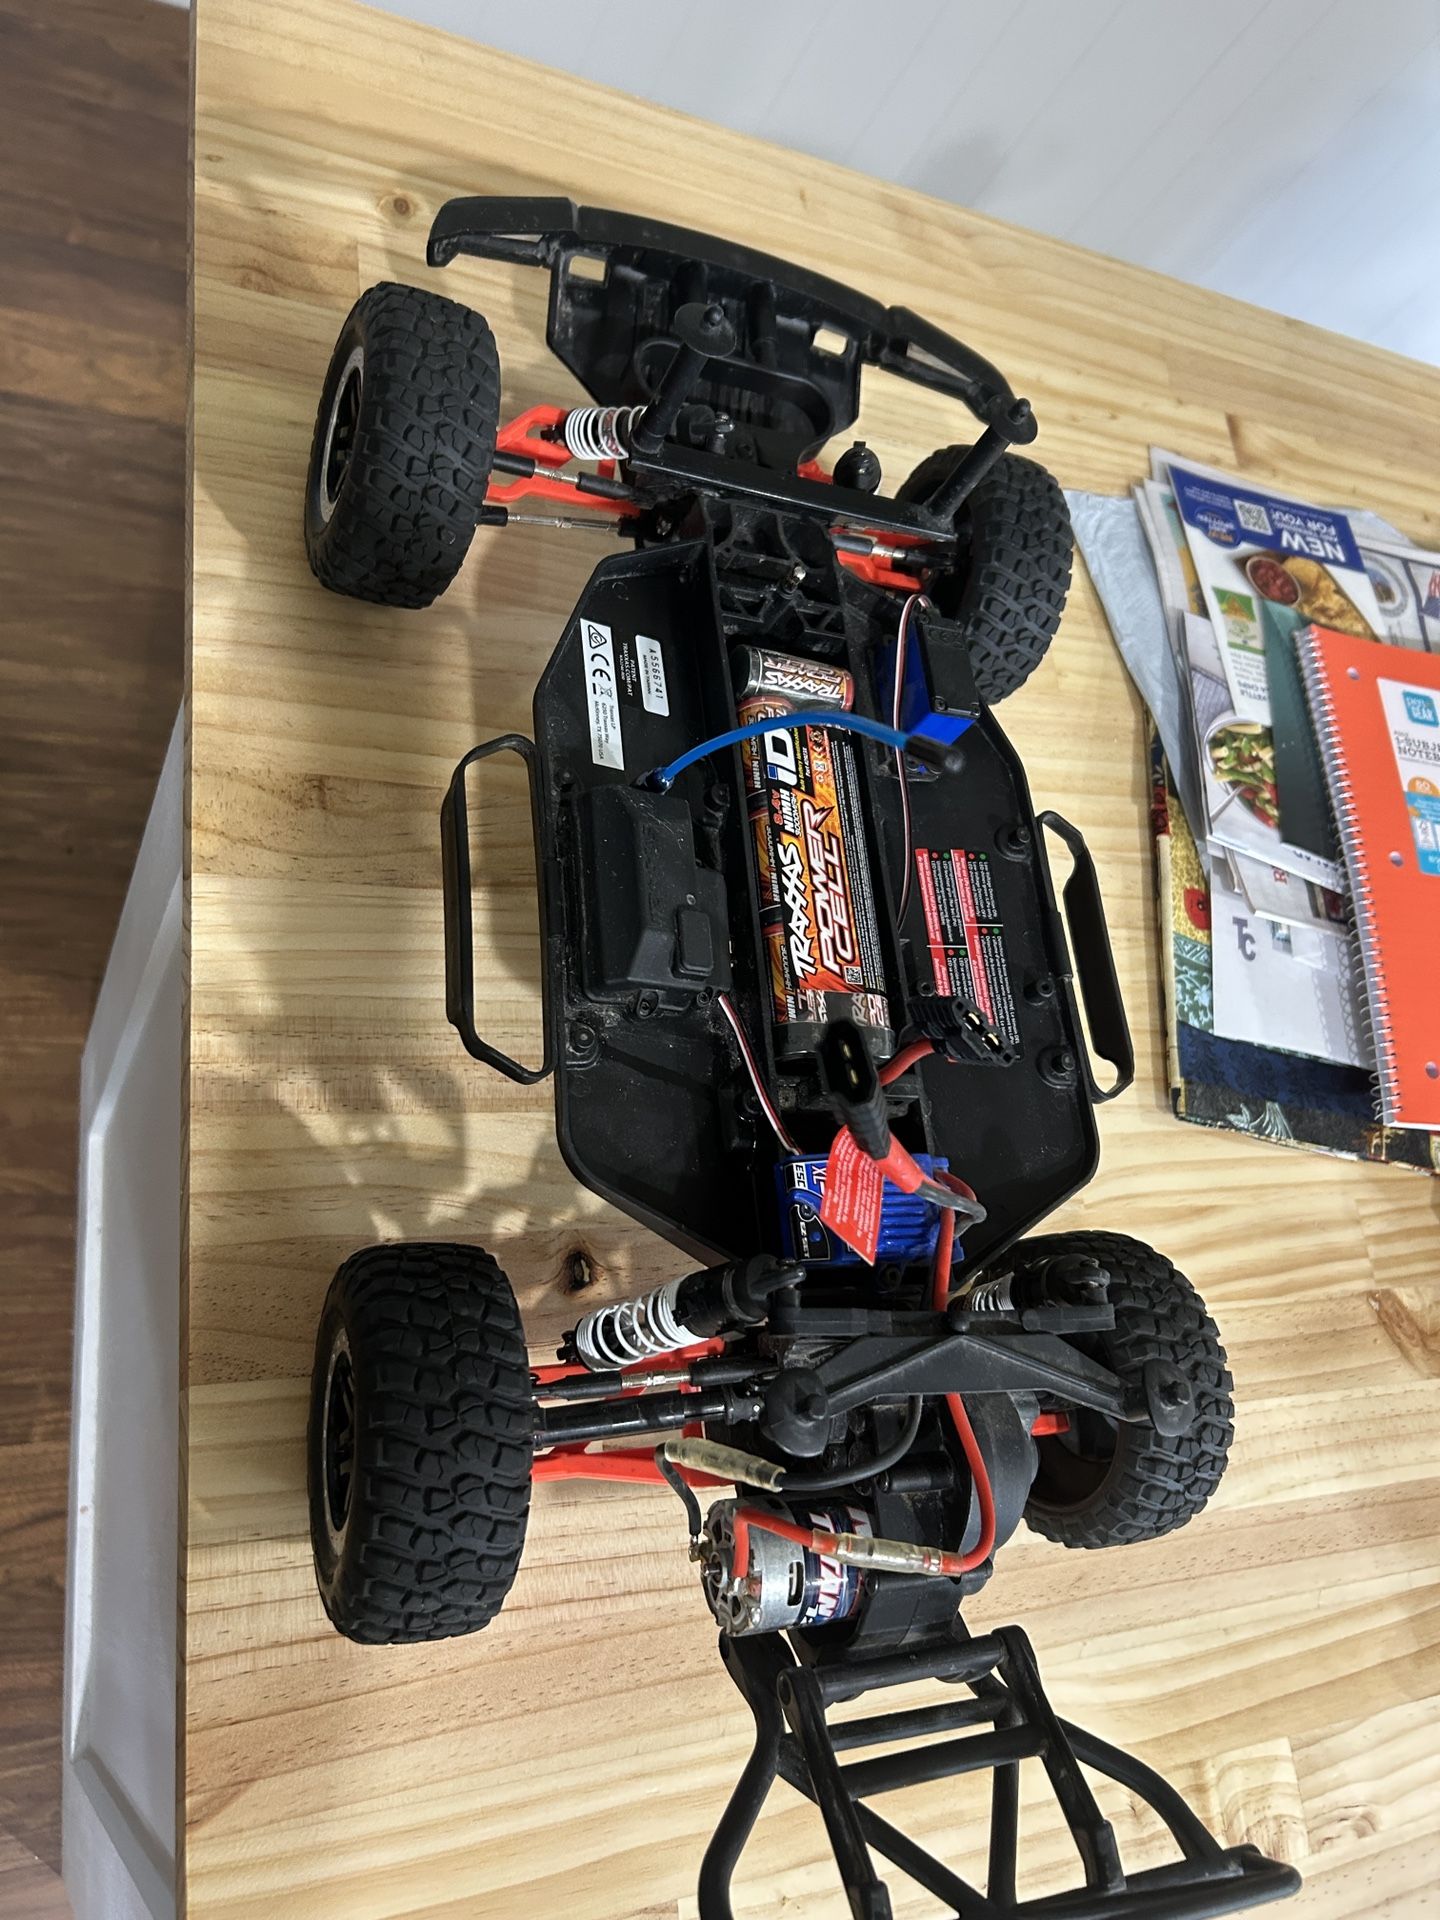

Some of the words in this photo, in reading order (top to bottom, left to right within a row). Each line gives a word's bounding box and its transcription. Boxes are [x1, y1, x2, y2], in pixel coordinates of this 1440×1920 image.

[1303, 516, 1336, 536] FOR
[1281, 530, 1346, 563] NEW
[628, 658, 637, 682] PATENT
[763, 670, 842, 699] TRAXXAS
[751, 760, 761, 788] NiMH
[802, 800, 841, 975] POWER
[825, 834, 855, 965] CELL
[778, 842, 818, 979] TRAXXAS
[795, 1164, 805, 1187] ESC
[809, 1512, 842, 1617] TTAN
